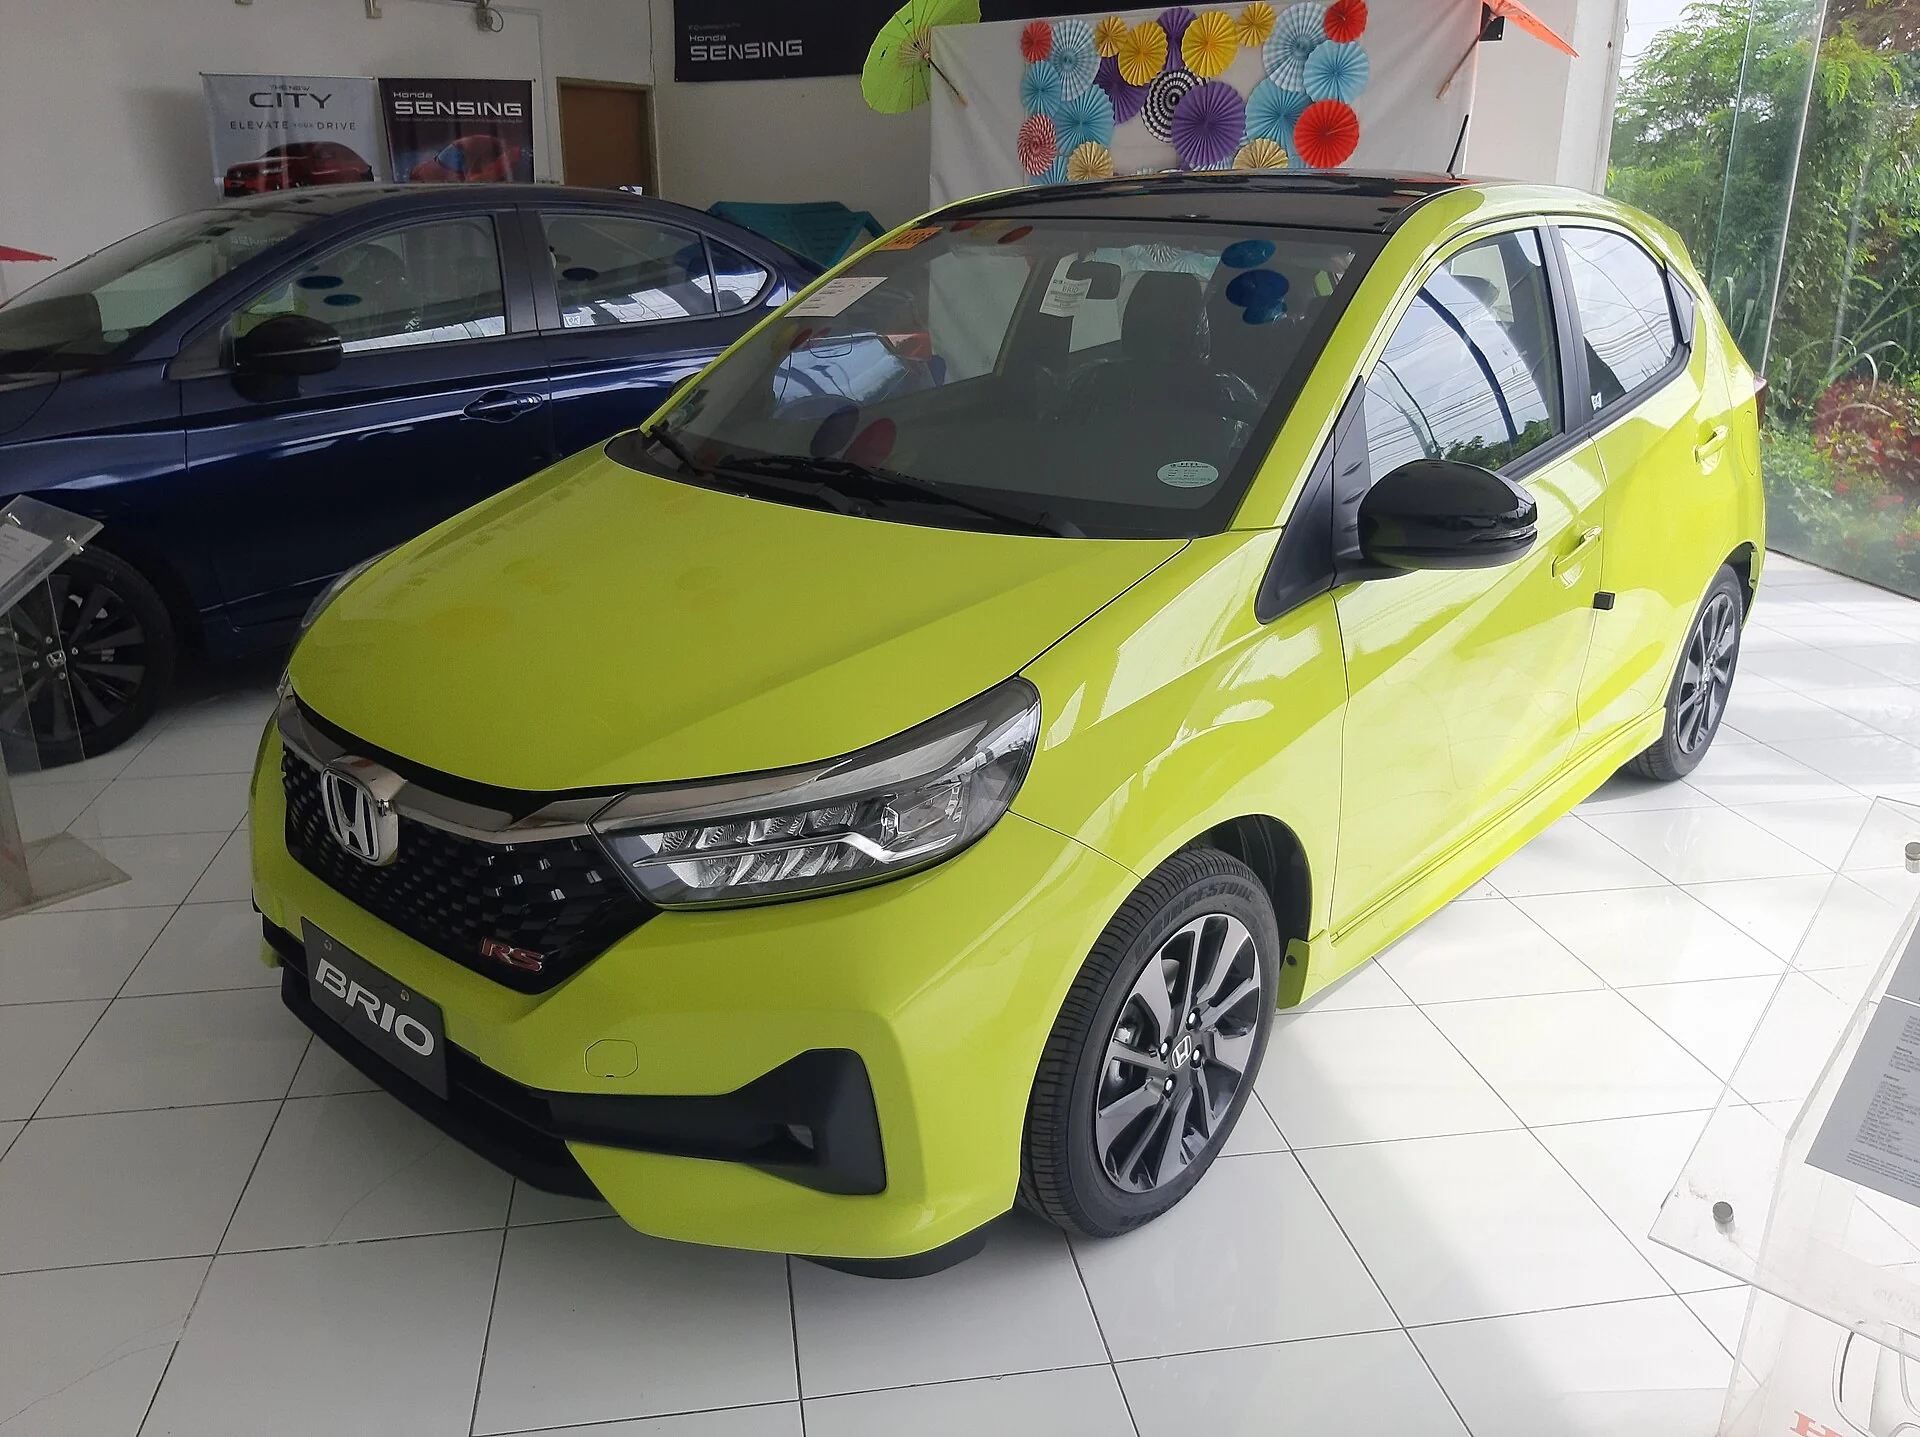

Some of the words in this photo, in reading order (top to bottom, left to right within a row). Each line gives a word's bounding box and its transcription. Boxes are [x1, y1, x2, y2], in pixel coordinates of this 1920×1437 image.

[689, 34, 727, 42] Honda
[690, 39, 803, 61] SENSING
[249, 92, 333, 109] CITY
[393, 91, 433, 99] Honda
[394, 101, 523, 117] SENSING
[230, 120, 289, 130] ELEVATE
[316, 121, 356, 131] DRIVE
[480, 936, 544, 973] RS
[314, 957, 435, 1057] BRIO
